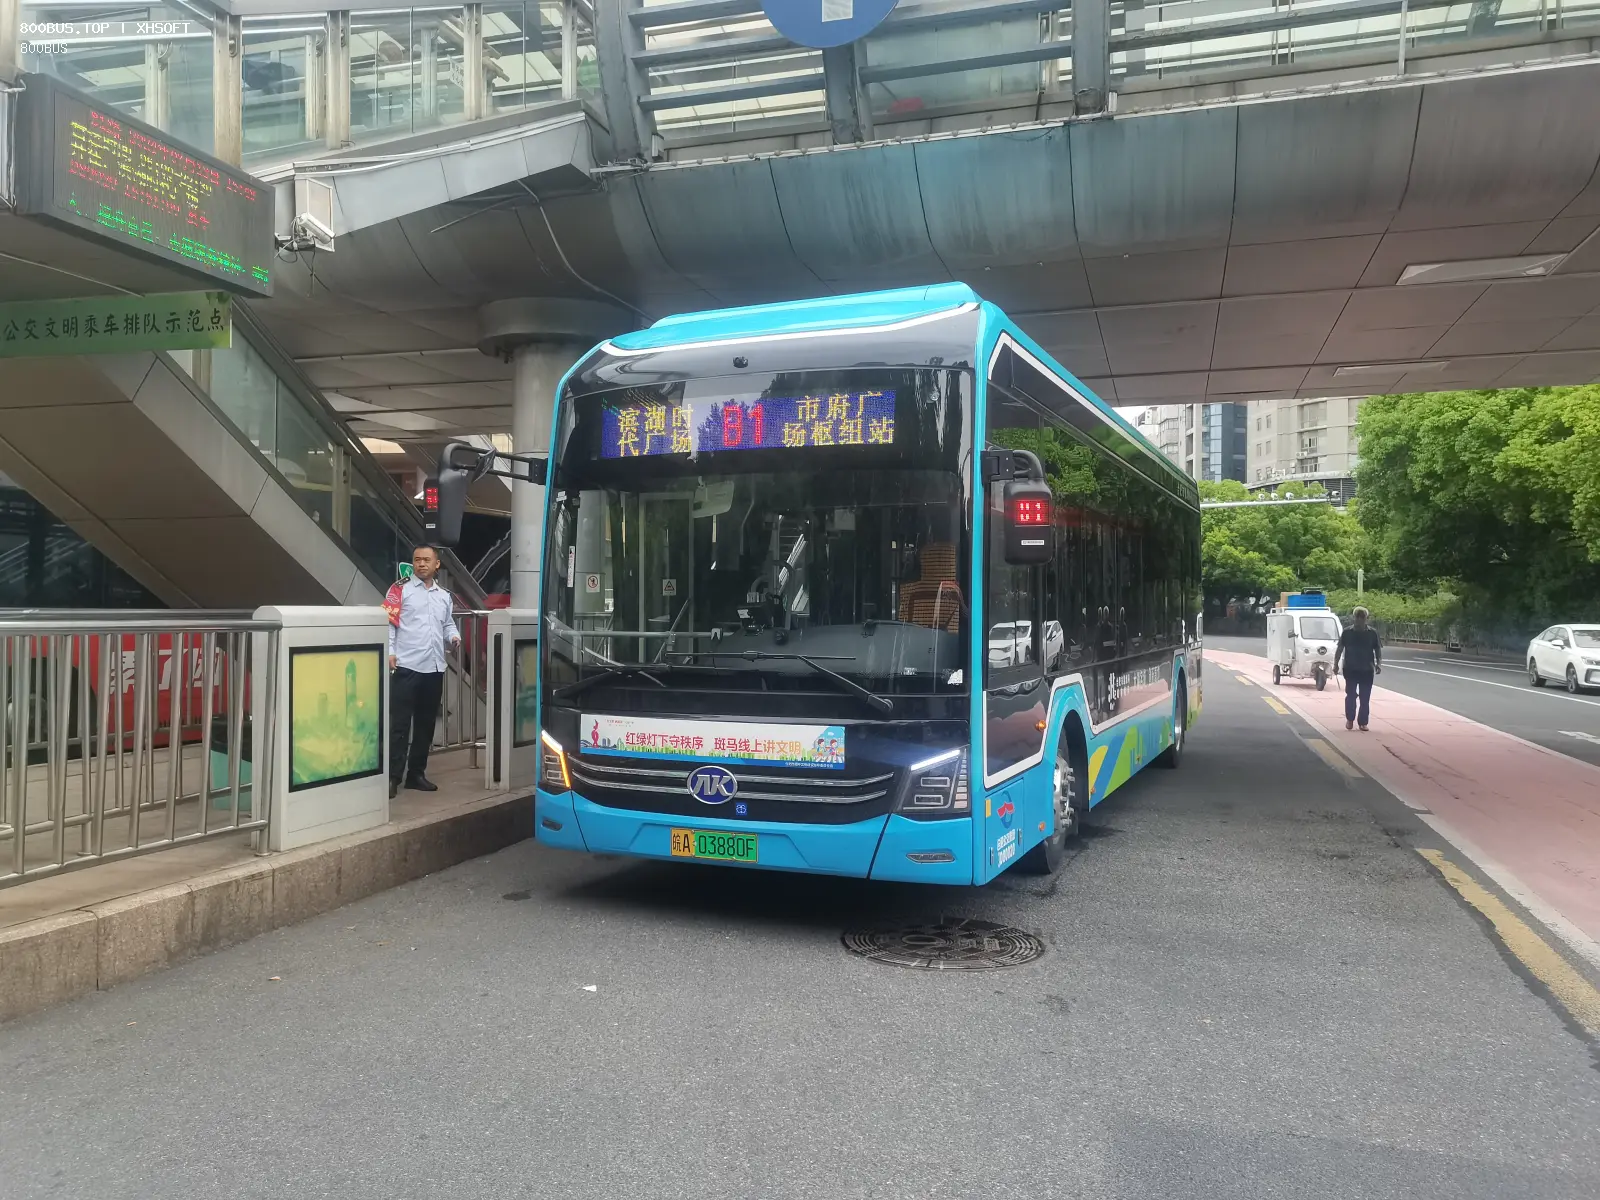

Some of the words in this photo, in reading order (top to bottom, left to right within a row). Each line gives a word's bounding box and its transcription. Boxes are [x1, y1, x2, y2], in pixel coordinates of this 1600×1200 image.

[3, 308, 225, 341] 公交文明乘车排队示范点
[796, 391, 882, 422] 市府广
[617, 428, 692, 457] 代广场
[625, 731, 704, 750] 红绿灯下守秩序
[714, 737, 802, 755] 斑马线上讲文明
[698, 835, 755, 857] 03880F
